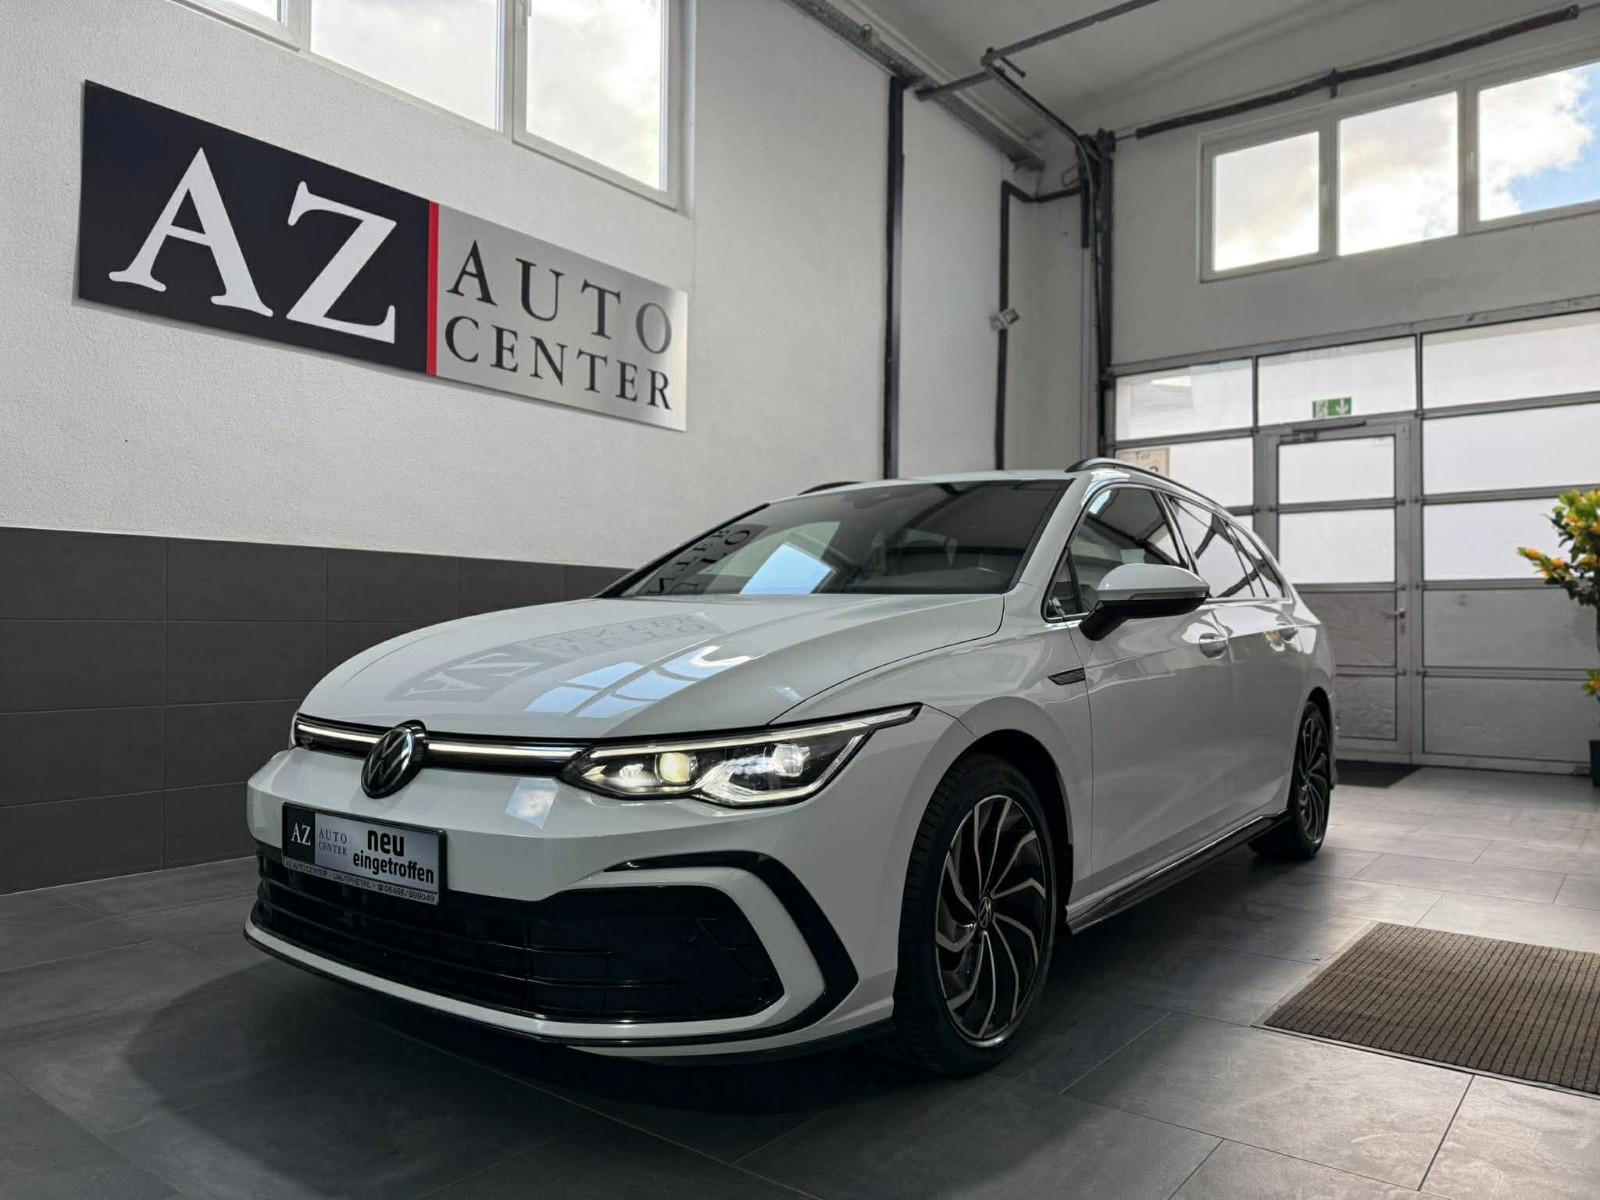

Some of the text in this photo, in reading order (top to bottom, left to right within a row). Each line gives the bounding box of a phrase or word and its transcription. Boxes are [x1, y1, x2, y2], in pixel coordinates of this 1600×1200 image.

[108, 147, 398, 344] AZ
[446, 239, 673, 355] AUTO
[444, 315, 673, 411] CENTER
[291, 821, 311, 846] AZ
[319, 827, 347, 844] AUTO
[319, 841, 348, 856] CENTER
[367, 830, 405, 857] neu
[353, 850, 434, 884] eingetroffen
